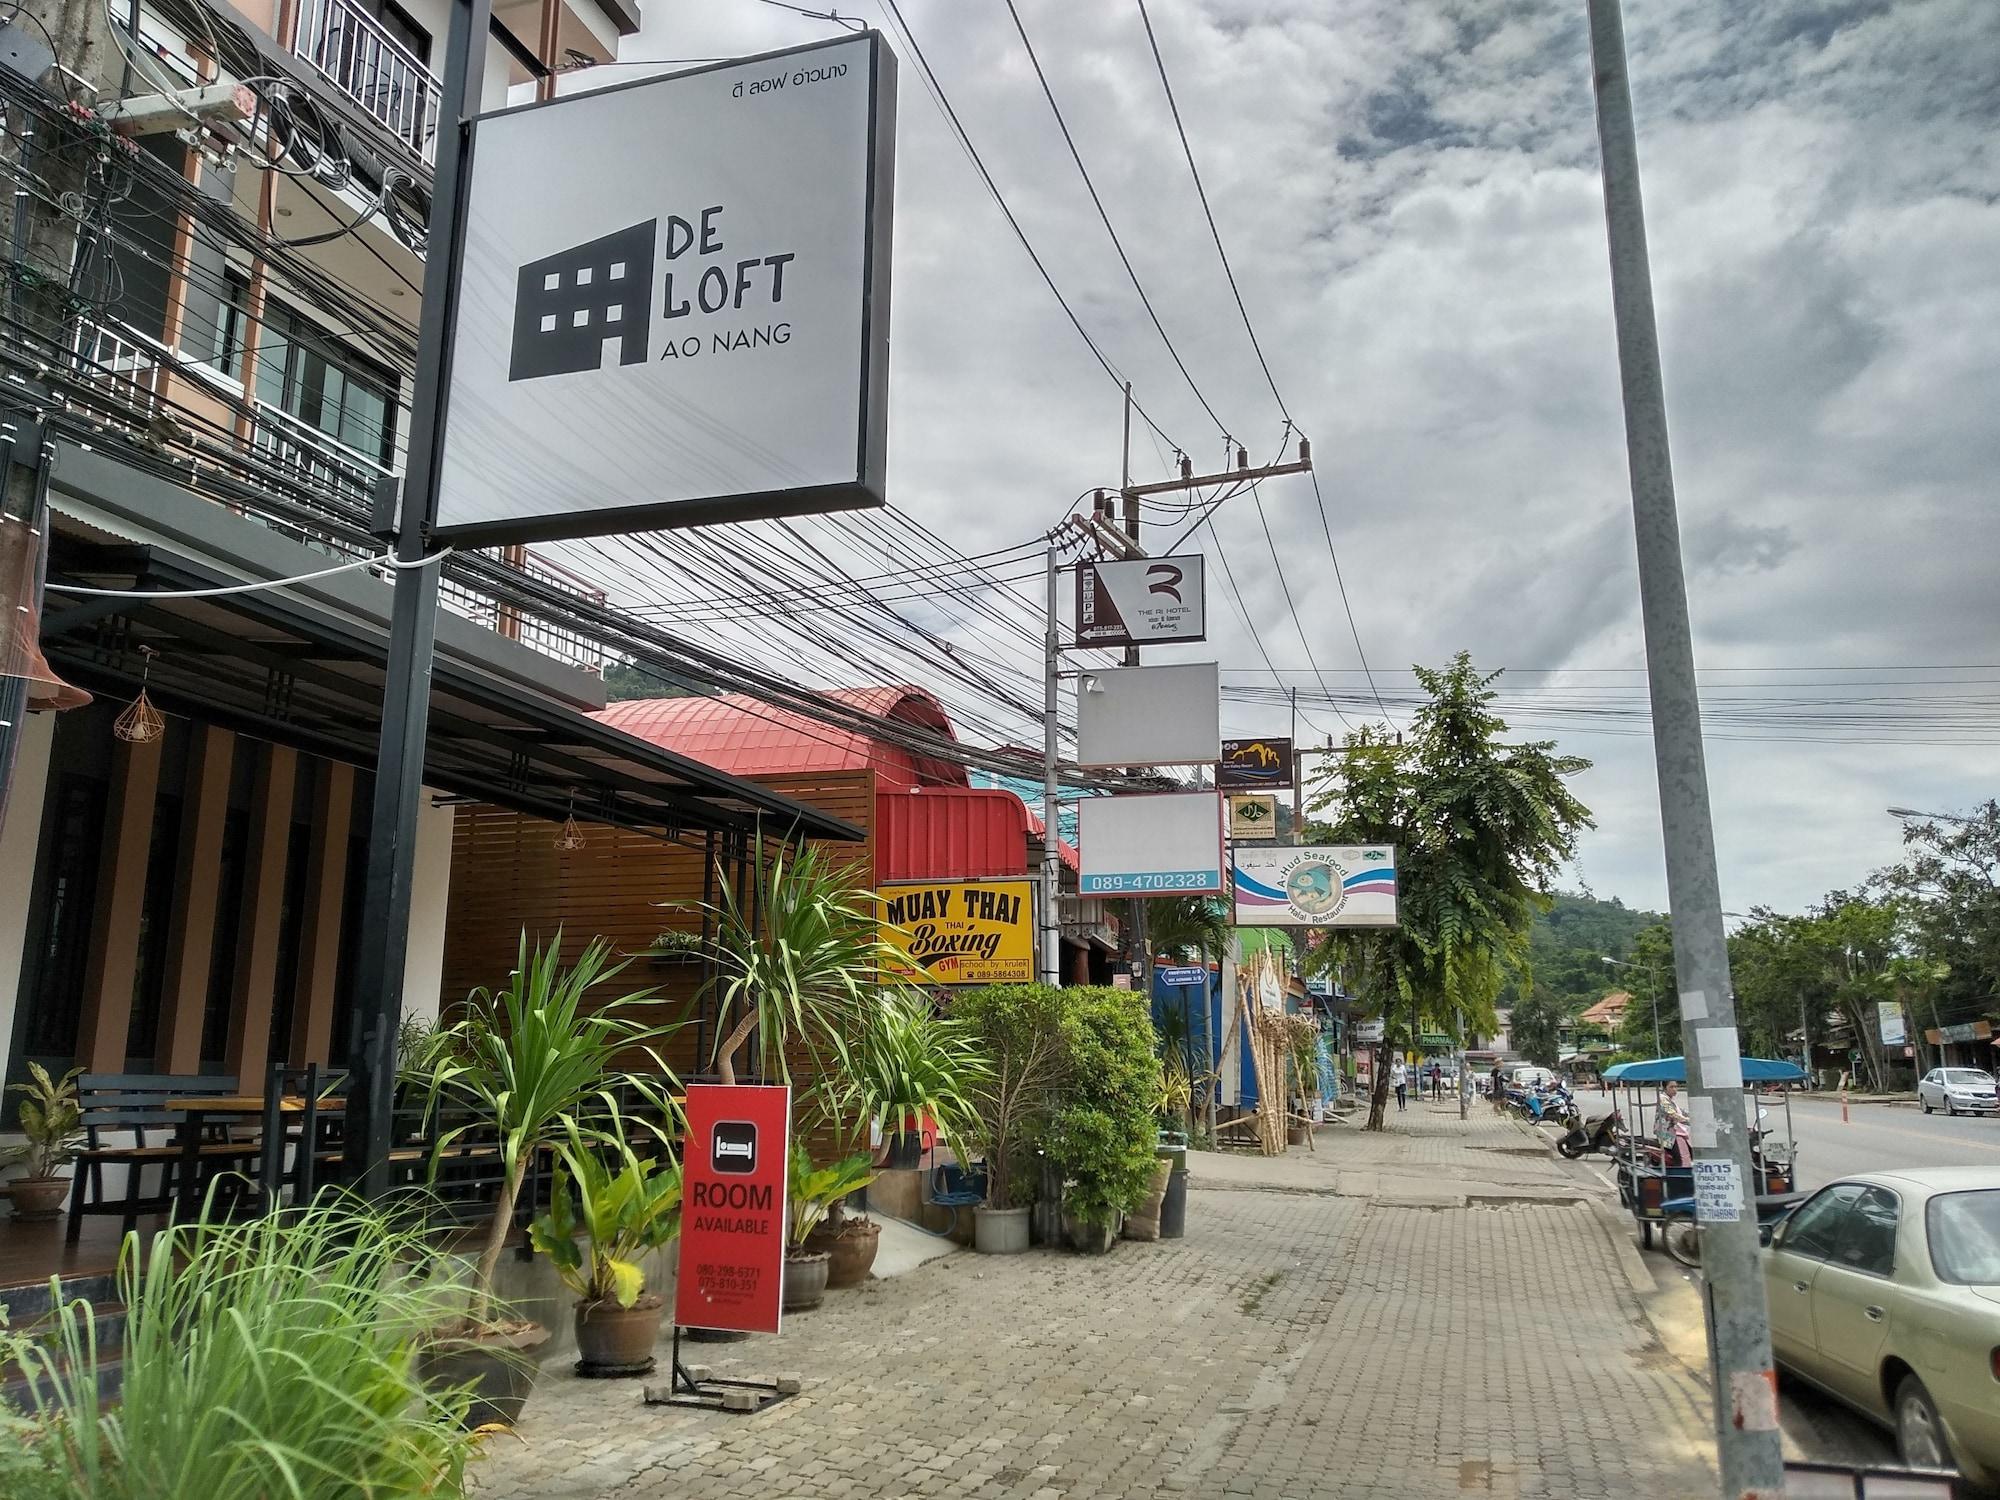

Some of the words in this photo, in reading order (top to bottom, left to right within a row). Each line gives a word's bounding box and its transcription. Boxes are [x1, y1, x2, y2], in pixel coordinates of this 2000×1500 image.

[732, 83, 744, 99] ดี
[749, 72, 788, 95] ลอฟ
[792, 62, 847, 86] อ่าวนาง
[665, 205, 724, 260] DE
[663, 253, 795, 319] LOFT
[661, 336, 700, 360] AO
[713, 323, 791, 354] NANG
[1092, 872, 1206, 890] 089-4702328
[1277, 855, 1301, 888] A-Hud
[1303, 851, 1349, 878] Seafood
[887, 889, 951, 926] MUAY
[964, 889, 1021, 925] THAI
[945, 921, 964, 929] THAI
[1287, 905, 1307, 922] Halal
[1312, 894, 1349, 924] Restaurant
[908, 923, 1002, 959] Boxing
[938, 957, 959, 972] GYM
[990, 960, 999, 970] by
[693, 1182, 772, 1210] ROOM
[694, 1216, 769, 1234] AVAILABLE
